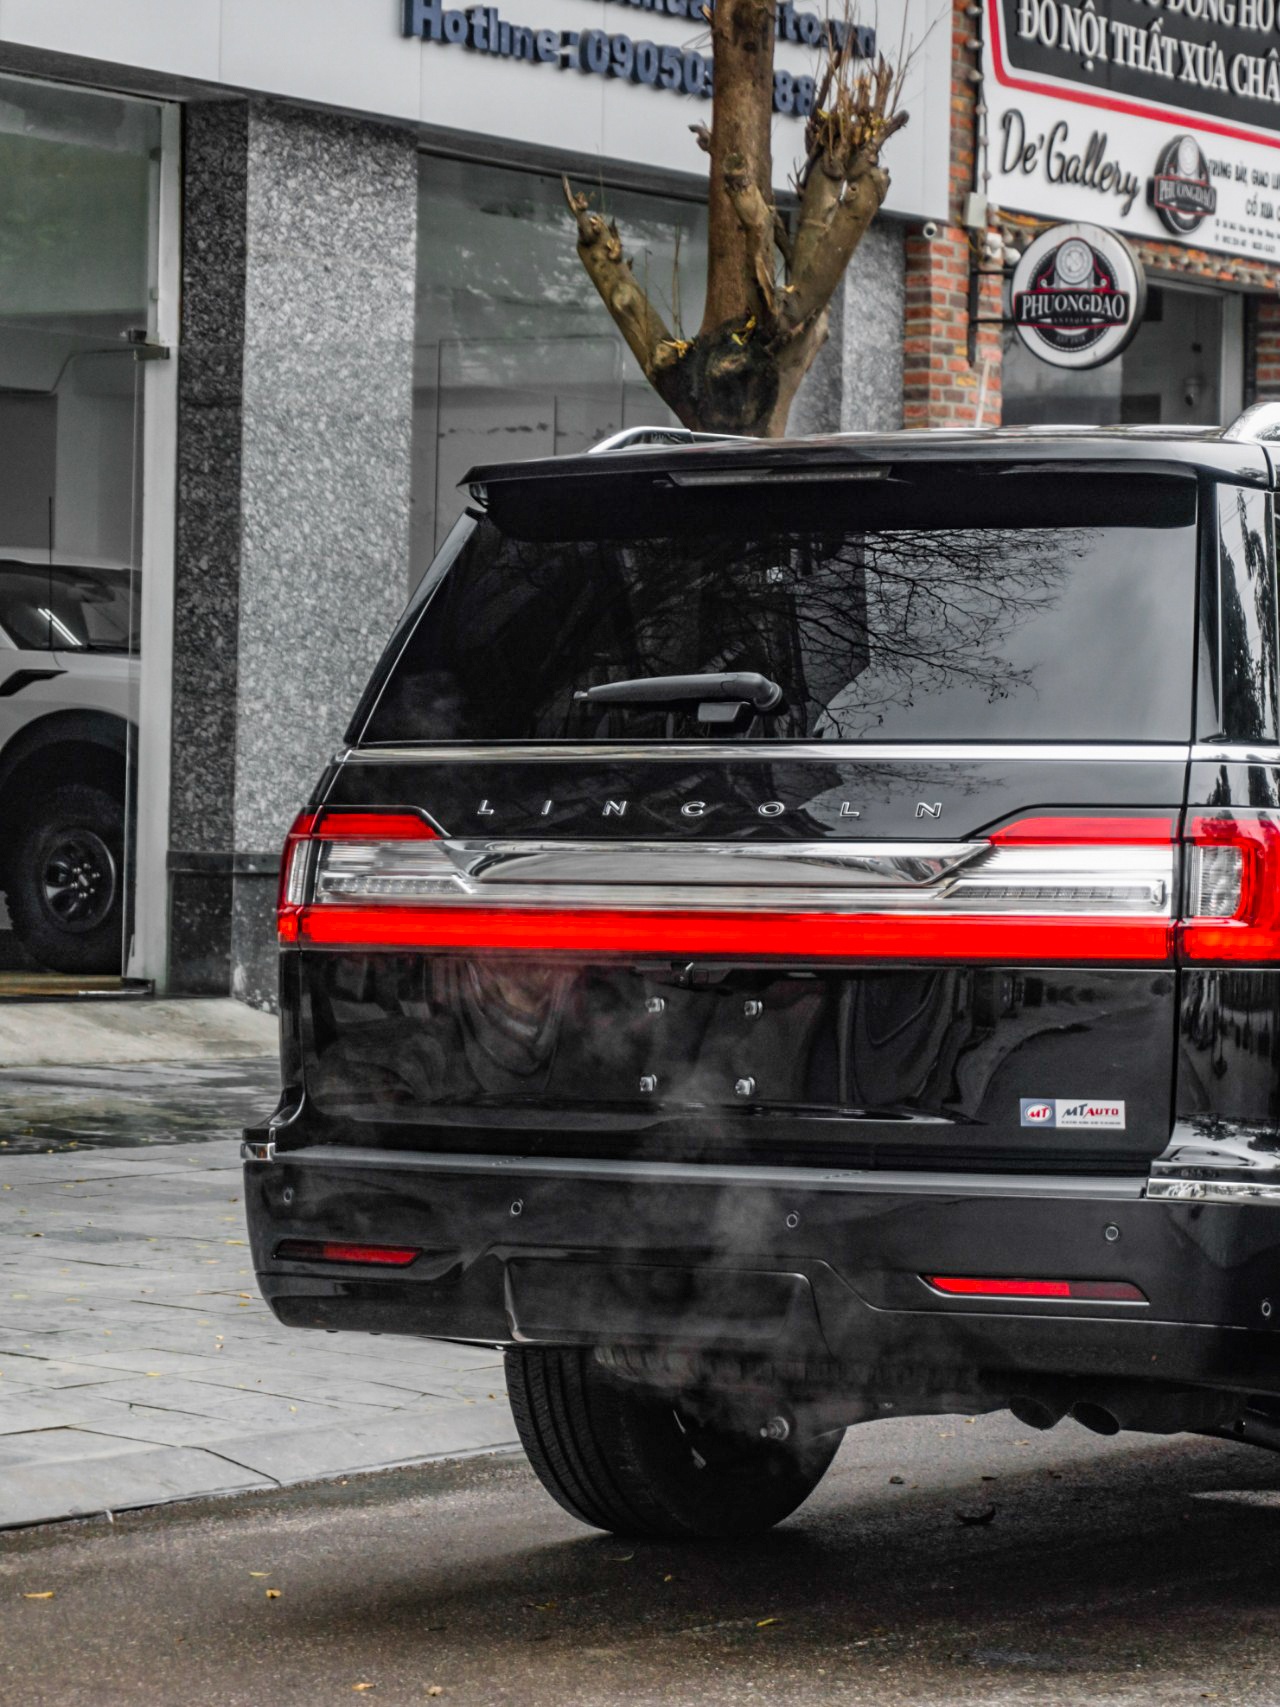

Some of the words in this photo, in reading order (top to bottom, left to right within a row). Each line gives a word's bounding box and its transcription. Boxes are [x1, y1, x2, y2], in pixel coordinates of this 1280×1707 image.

[1060, 0, 1108, 71] NỘI
[1111, 17, 1178, 78] THẤT
[1179, 40, 1229, 91] XƯA
[1022, 293, 1125, 321] PHUONGDAO
[476, 799, 943, 820] LINCOLN
